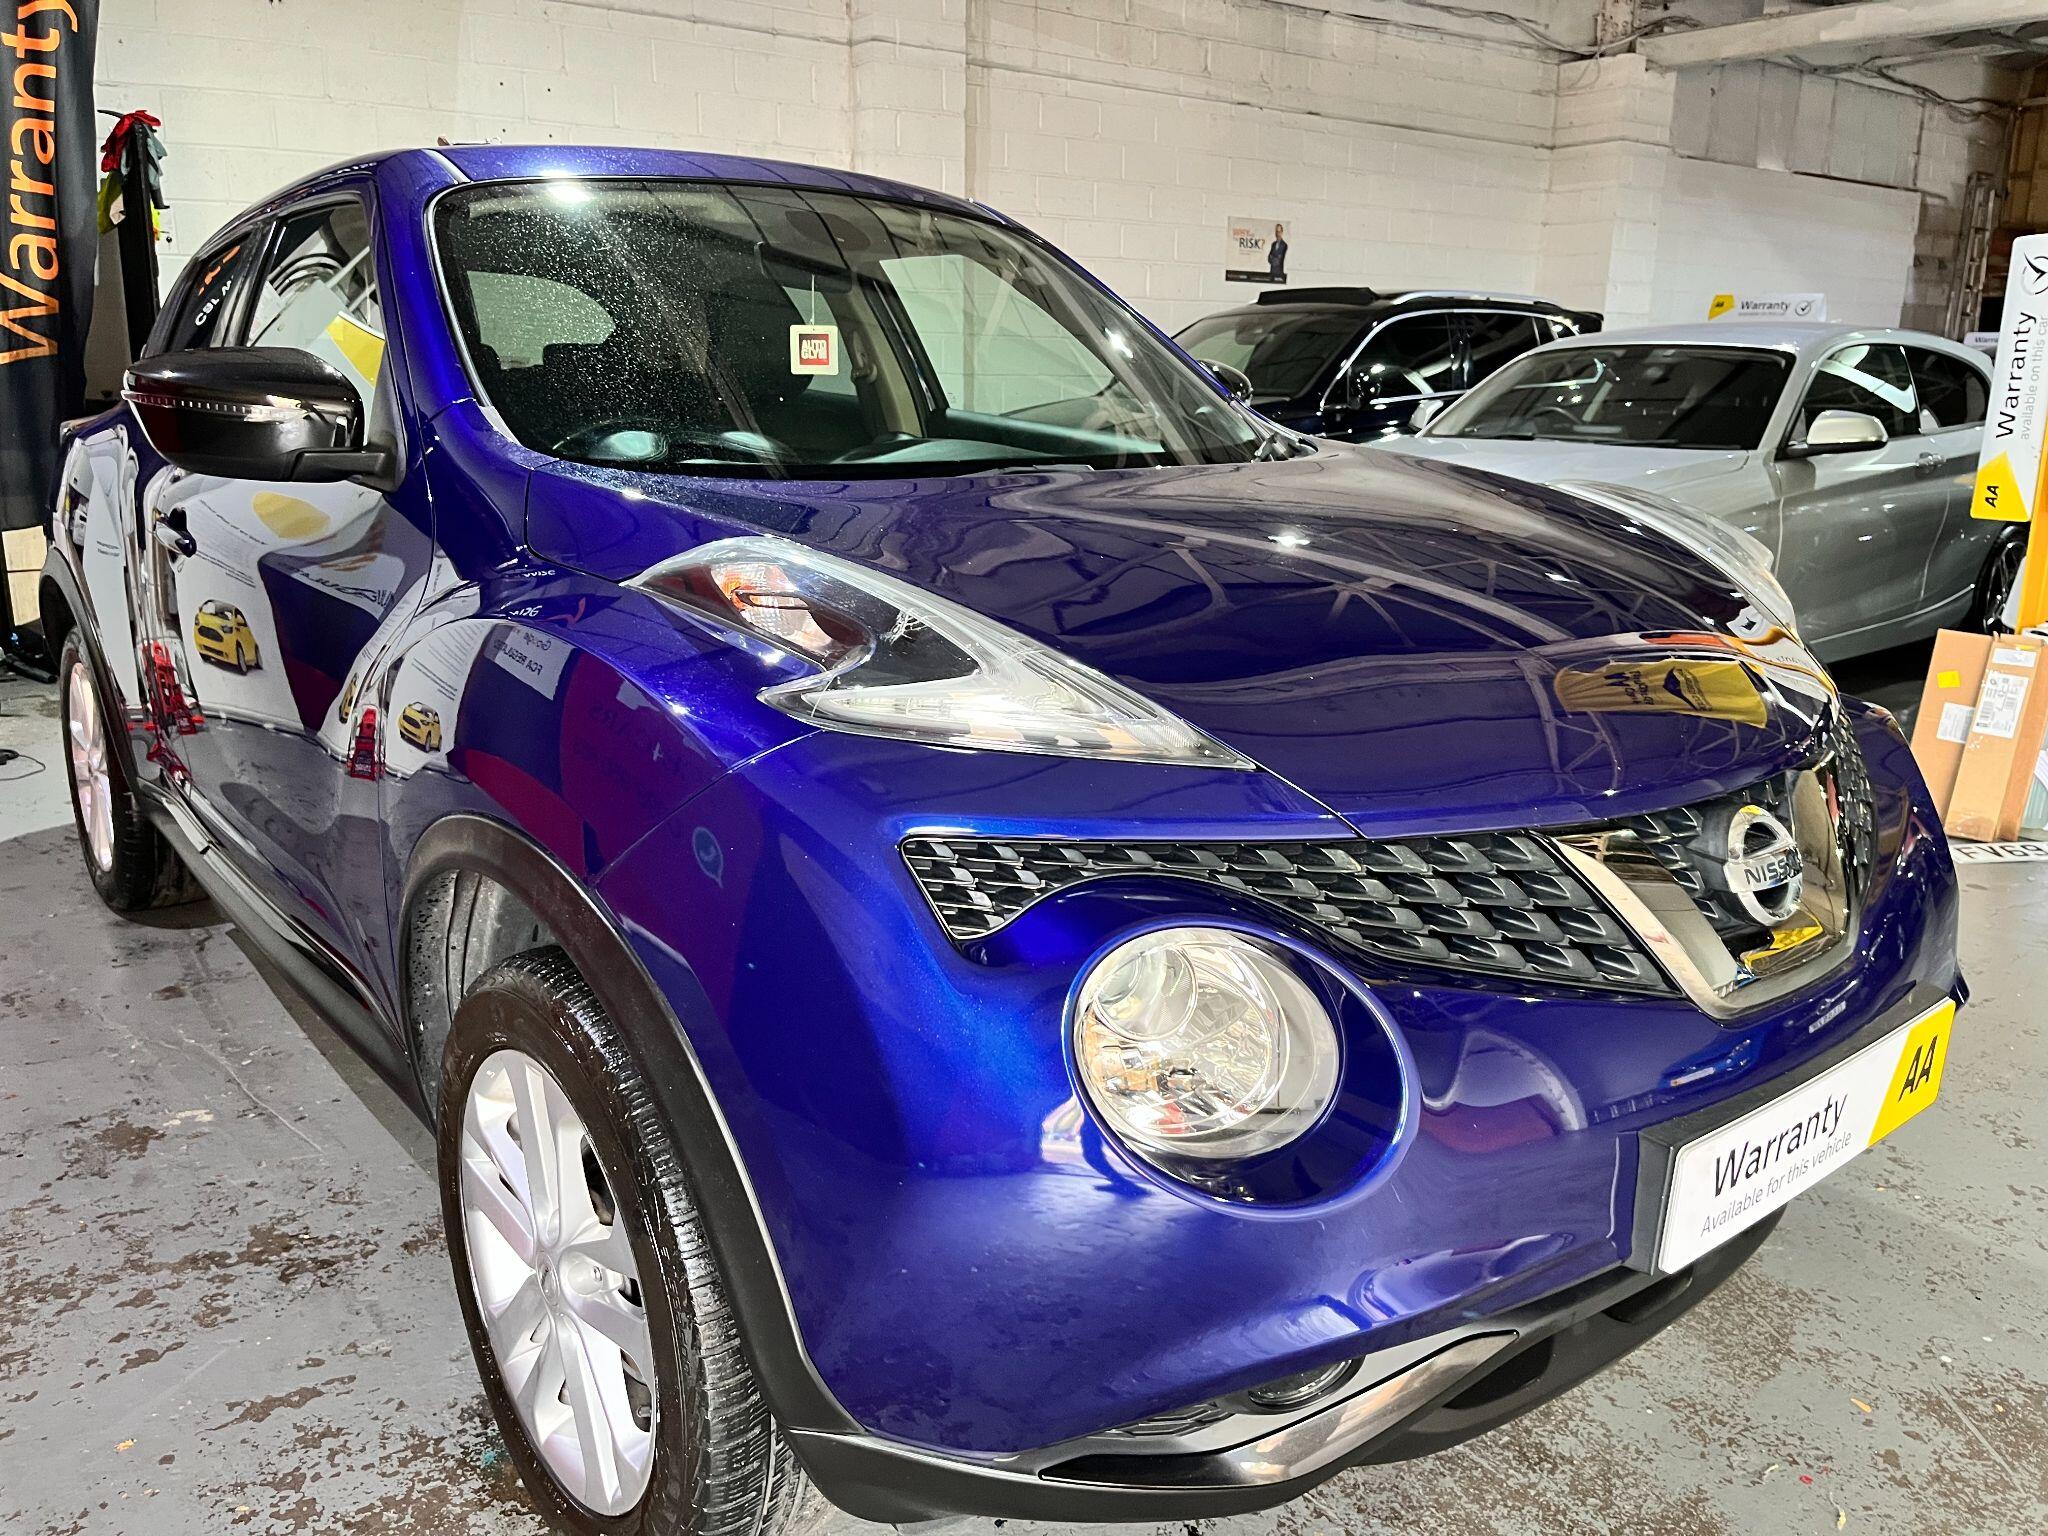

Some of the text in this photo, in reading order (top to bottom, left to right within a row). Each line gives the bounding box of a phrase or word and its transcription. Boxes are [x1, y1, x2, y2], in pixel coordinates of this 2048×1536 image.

[1239, 237, 1265, 249] RISK?
[1741, 300, 1789, 312] Warranty
[1996, 311, 2037, 438] Warranty
[2021, 314, 2048, 440] available on this car
[1984, 484, 1999, 508] AA
[1744, 847, 1800, 885] NISS
[1955, 845, 2048, 860] FV69
[1898, 1034, 1938, 1103] AA
[1714, 1094, 1847, 1197] Warranty
[1701, 1131, 1852, 1237] Available for this vehicle
